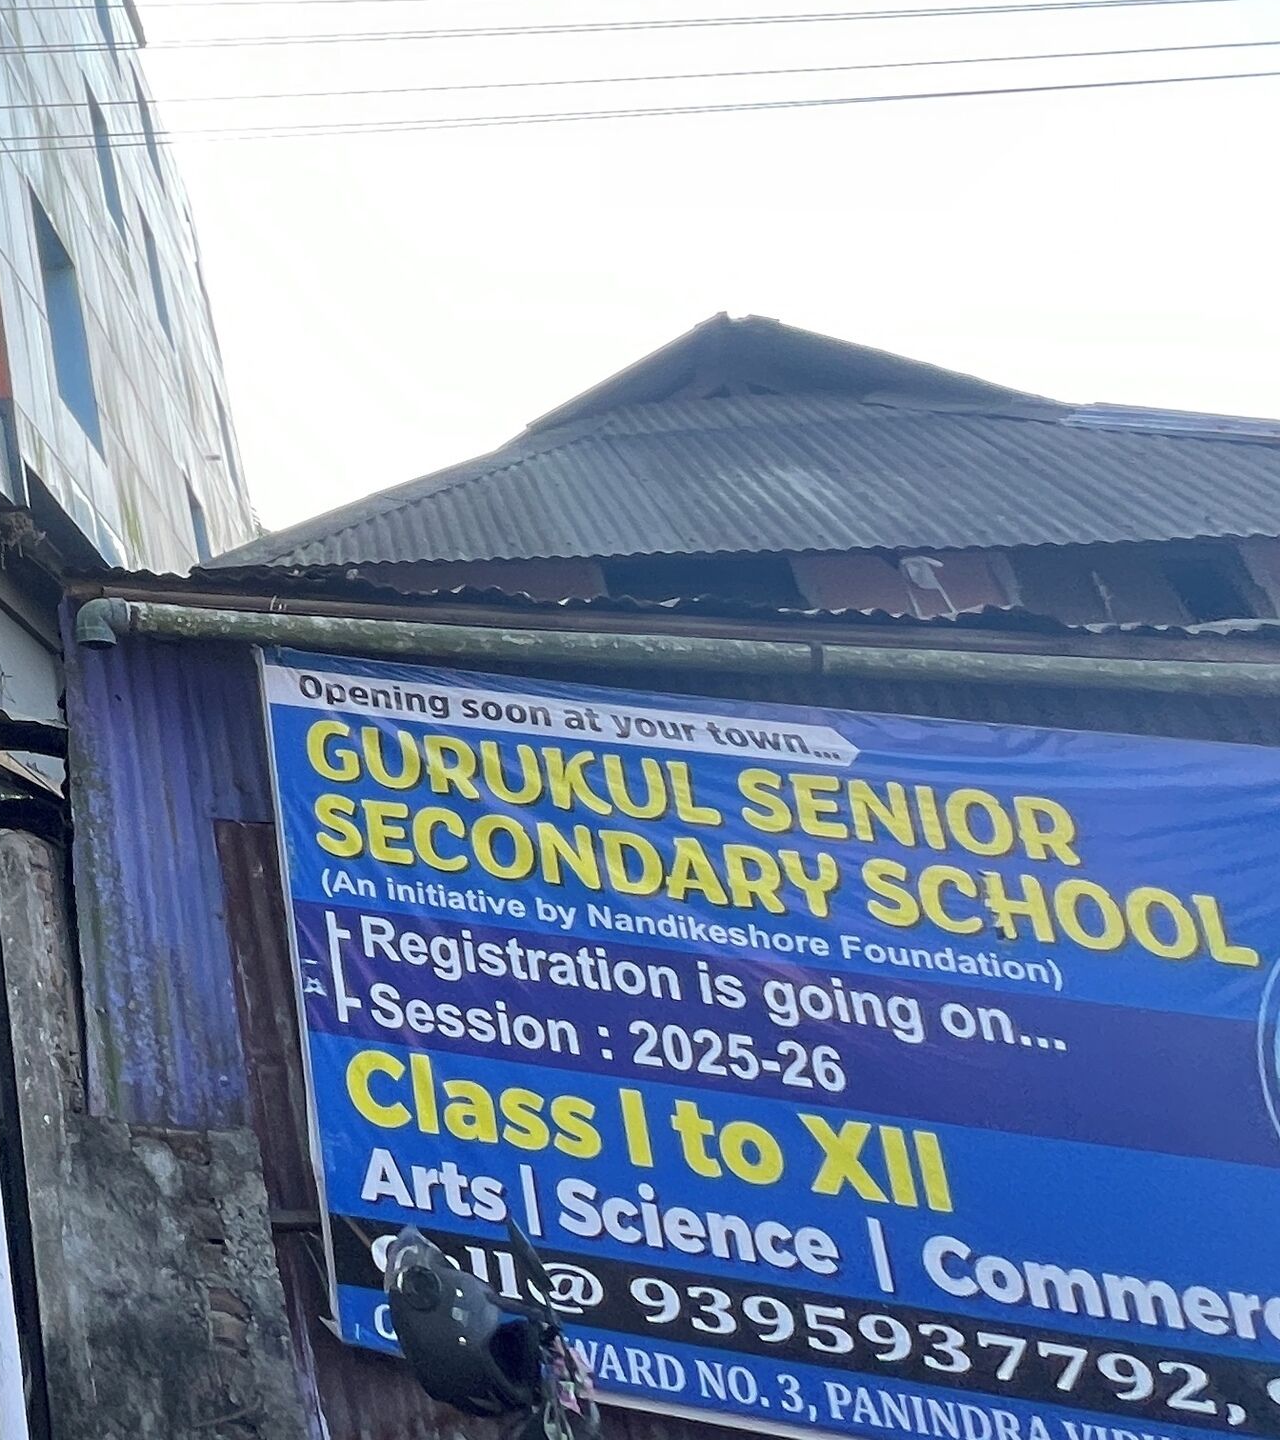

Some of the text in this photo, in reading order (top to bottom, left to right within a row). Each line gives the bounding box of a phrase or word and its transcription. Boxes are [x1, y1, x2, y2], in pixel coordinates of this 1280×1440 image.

[299, 673, 841, 760] Opening soon at your town...
[306, 719, 1081, 866] GURUKUL SENIOR
[314, 793, 1260, 967] SECONDARY SCHOOL
[321, 868, 1064, 992] (An initiative by Nandikeshore Foundation)
[360, 914, 1068, 1052] Registration is going on...
[369, 983, 581, 1056] Session
[628, 1020, 847, 1093] 2025-26
[345, 1049, 954, 1213] Class I to XII
[360, 1147, 508, 1222] Arts
[556, 1176, 840, 1275] Science
[630, 1276, 1246, 1427] 9395937792,
[695, 1361, 770, 1408] NO.
[780, 1373, 817, 1424] 3,
[823, 1381, 1051, 1440] PANINDRA
